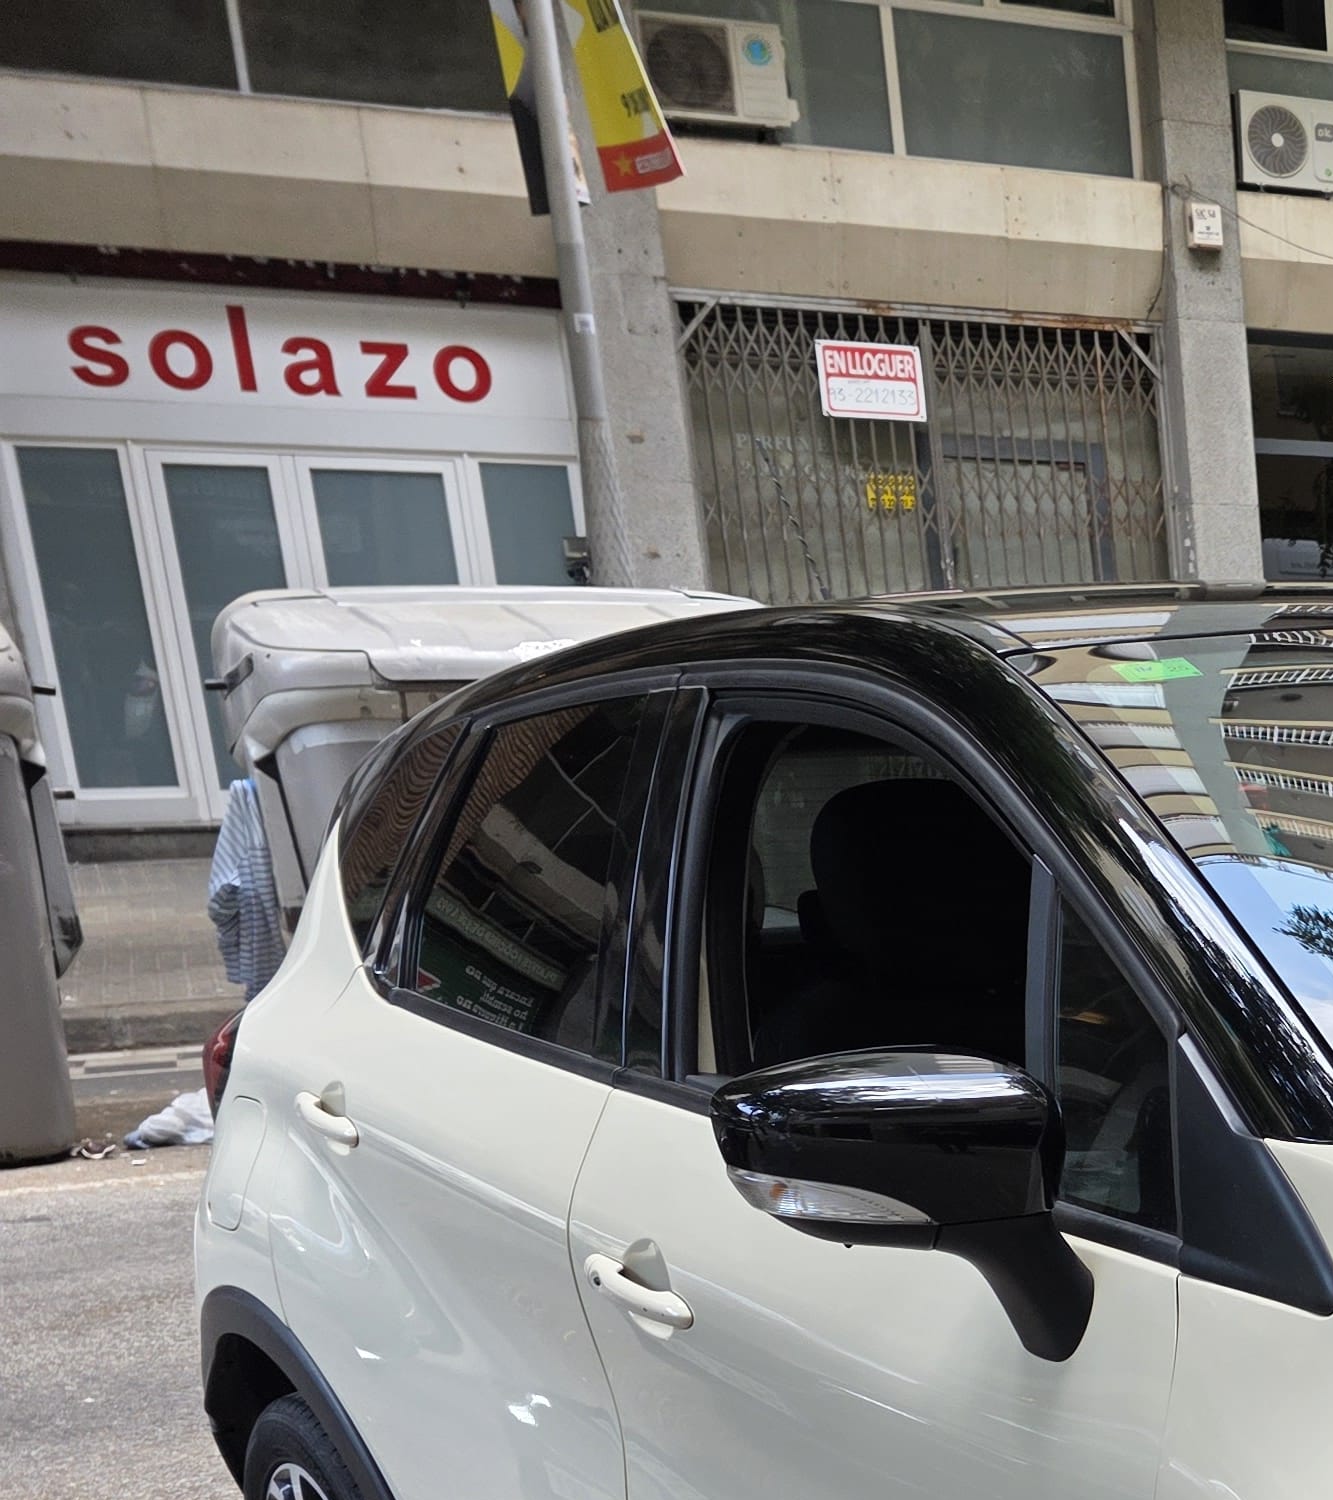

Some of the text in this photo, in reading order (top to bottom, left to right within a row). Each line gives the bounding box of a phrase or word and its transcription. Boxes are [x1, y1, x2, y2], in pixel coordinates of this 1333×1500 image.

[68, 304, 493, 404] solazo
[825, 350, 916, 379] EN LLOGUER
